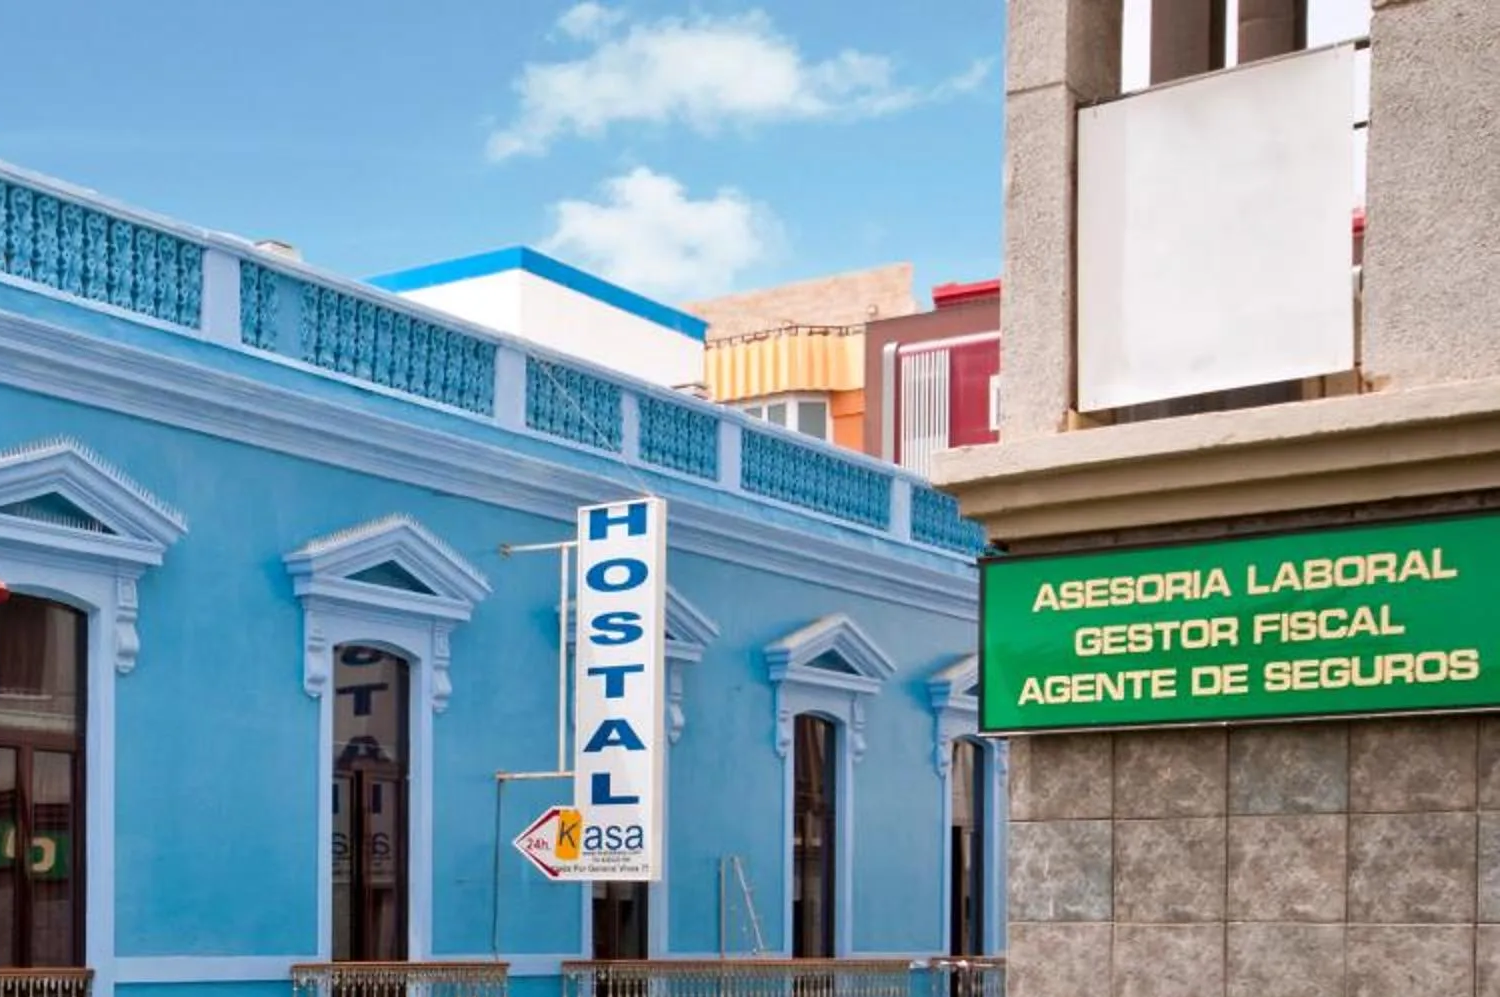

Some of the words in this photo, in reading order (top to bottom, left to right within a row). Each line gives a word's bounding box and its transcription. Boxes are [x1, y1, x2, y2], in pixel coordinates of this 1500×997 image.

[1031, 568, 1232, 613] ASESORIA
[1246, 548, 1458, 596] LABORAL
[583, 502, 649, 806] HOSTAL
[1074, 617, 1239, 657] GESTOR
[1253, 604, 1406, 645] FISCAL
[1017, 668, 1177, 706] AGENTE
[1190, 663, 1249, 697] DE
[1263, 648, 1480, 692] SEGUROS
